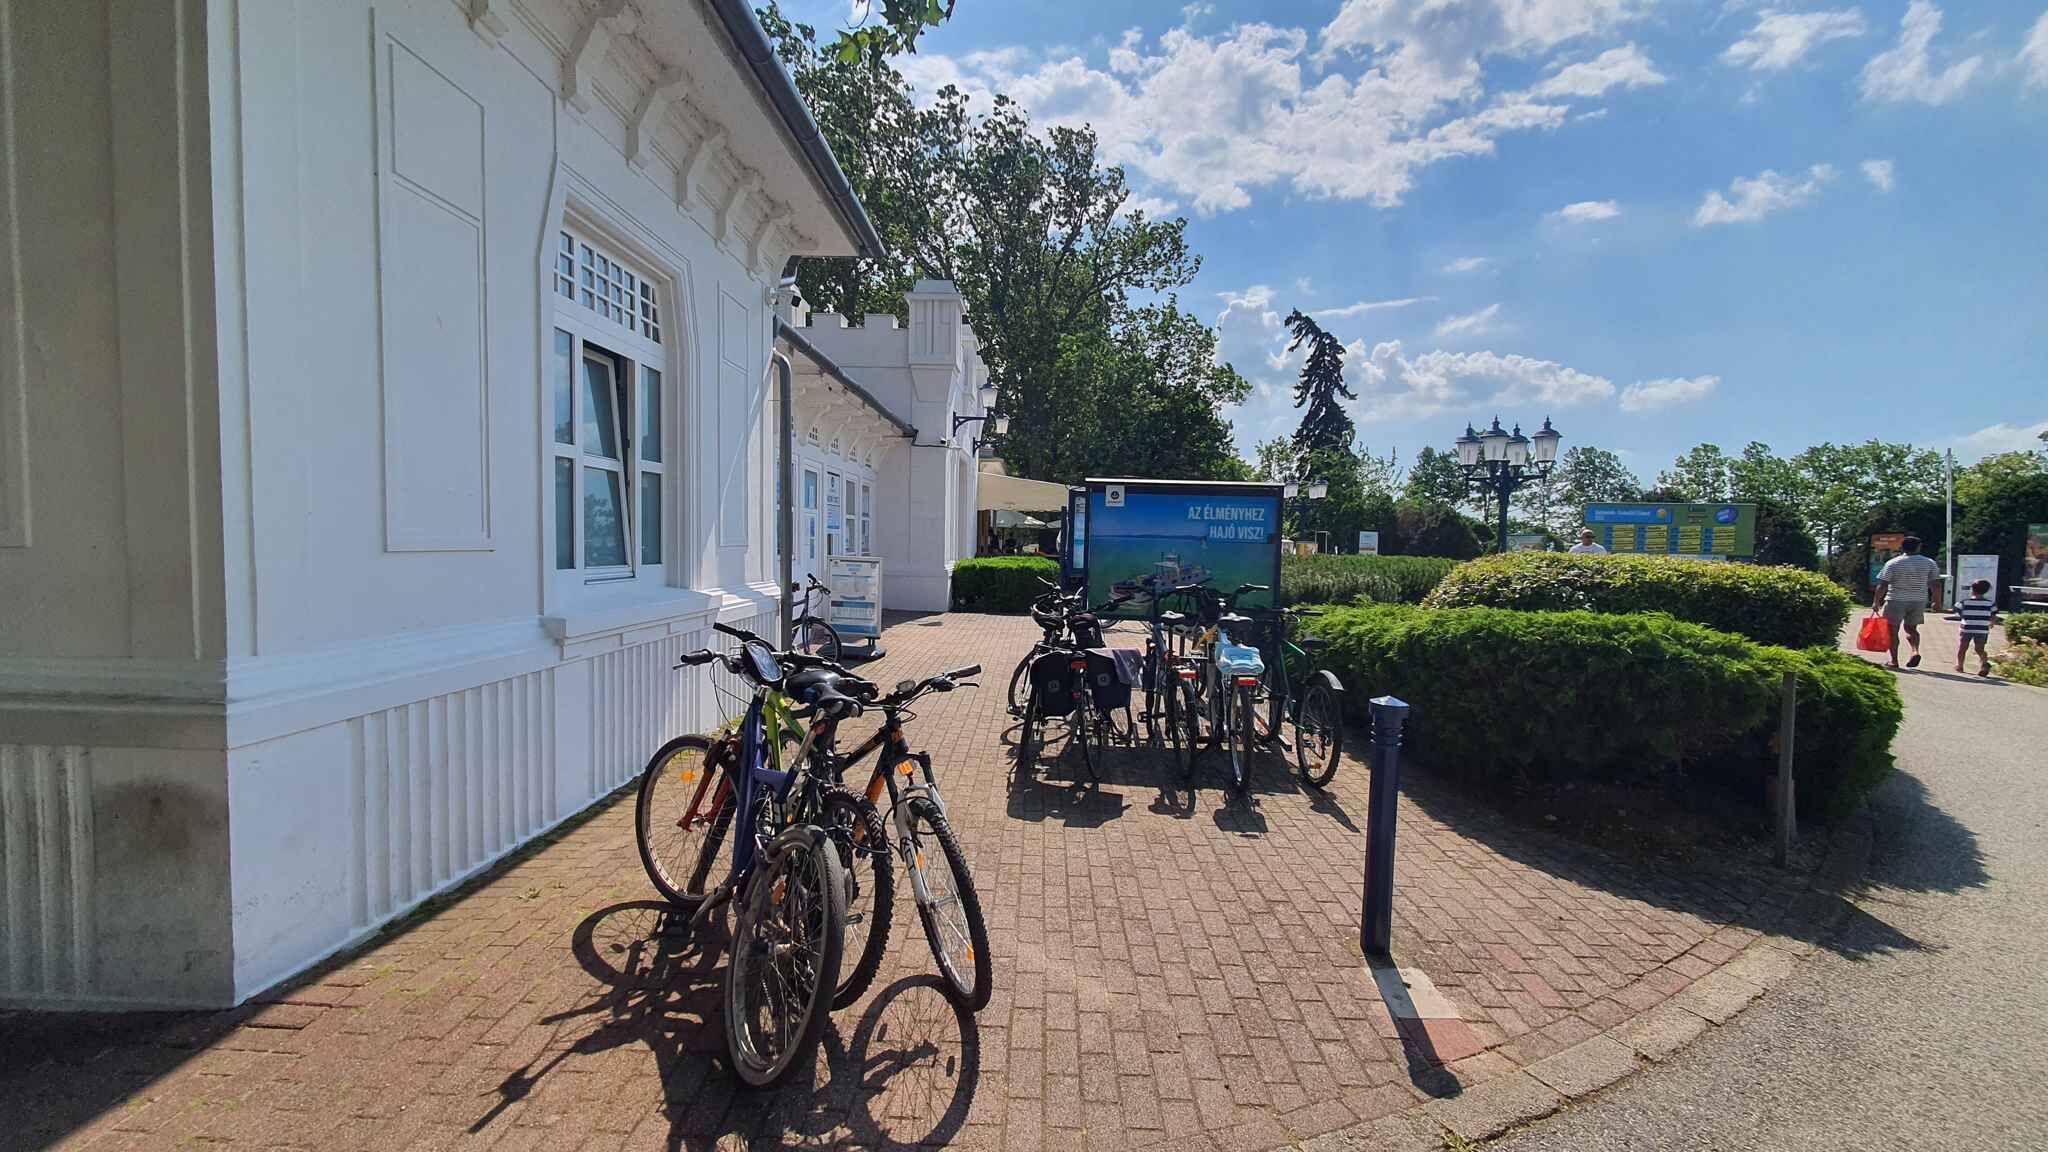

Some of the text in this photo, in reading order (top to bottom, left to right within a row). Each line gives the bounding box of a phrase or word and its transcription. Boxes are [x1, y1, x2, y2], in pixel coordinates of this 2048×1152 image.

[1187, 504, 1265, 521] AZ ÉLMÉNYHEZ
[1209, 523, 1265, 540] HAJÓ VISZ!
